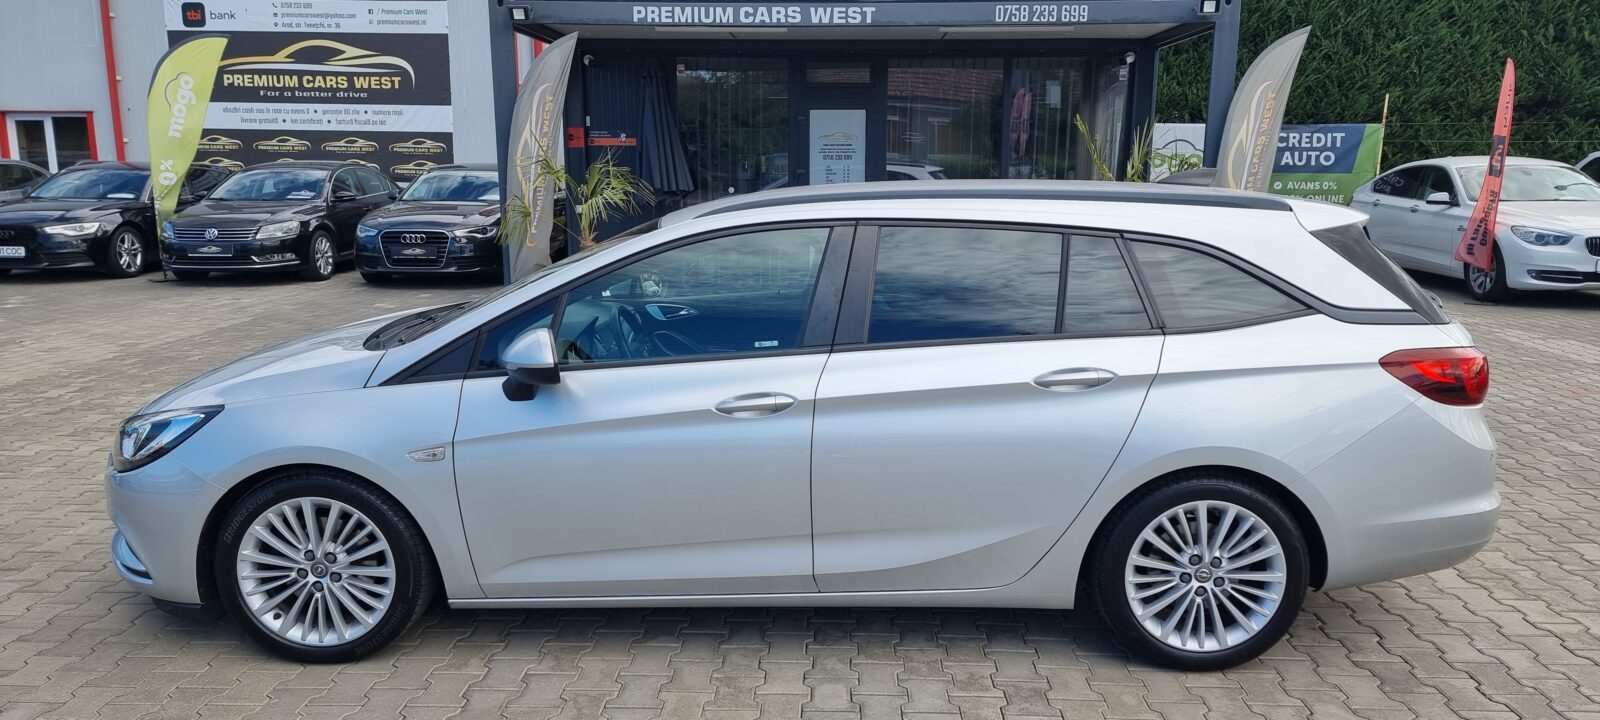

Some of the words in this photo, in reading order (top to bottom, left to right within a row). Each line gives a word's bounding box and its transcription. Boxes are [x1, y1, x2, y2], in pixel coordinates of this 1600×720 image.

[186, 9, 202, 20] tbi
[210, 10, 236, 20] bank
[632, 6, 734, 24] PREMIUM
[739, 7, 802, 24] CARS
[810, 7, 876, 24] WEST
[995, 4, 1028, 22] 0758
[1032, 5, 1058, 22] 233
[1061, 5, 1088, 22] 699
[223, 74, 299, 88] PREMIUM
[302, 76, 348, 89] CARS
[354, 76, 402, 89] WEST
[168, 75, 196, 138] mogo
[1277, 132, 1345, 148] CREDIT
[1280, 151, 1335, 166] AUTO
[158, 160, 177, 186] 0%
[1287, 181, 1320, 190] AVANS
[1322, 182, 1337, 190] 0%
